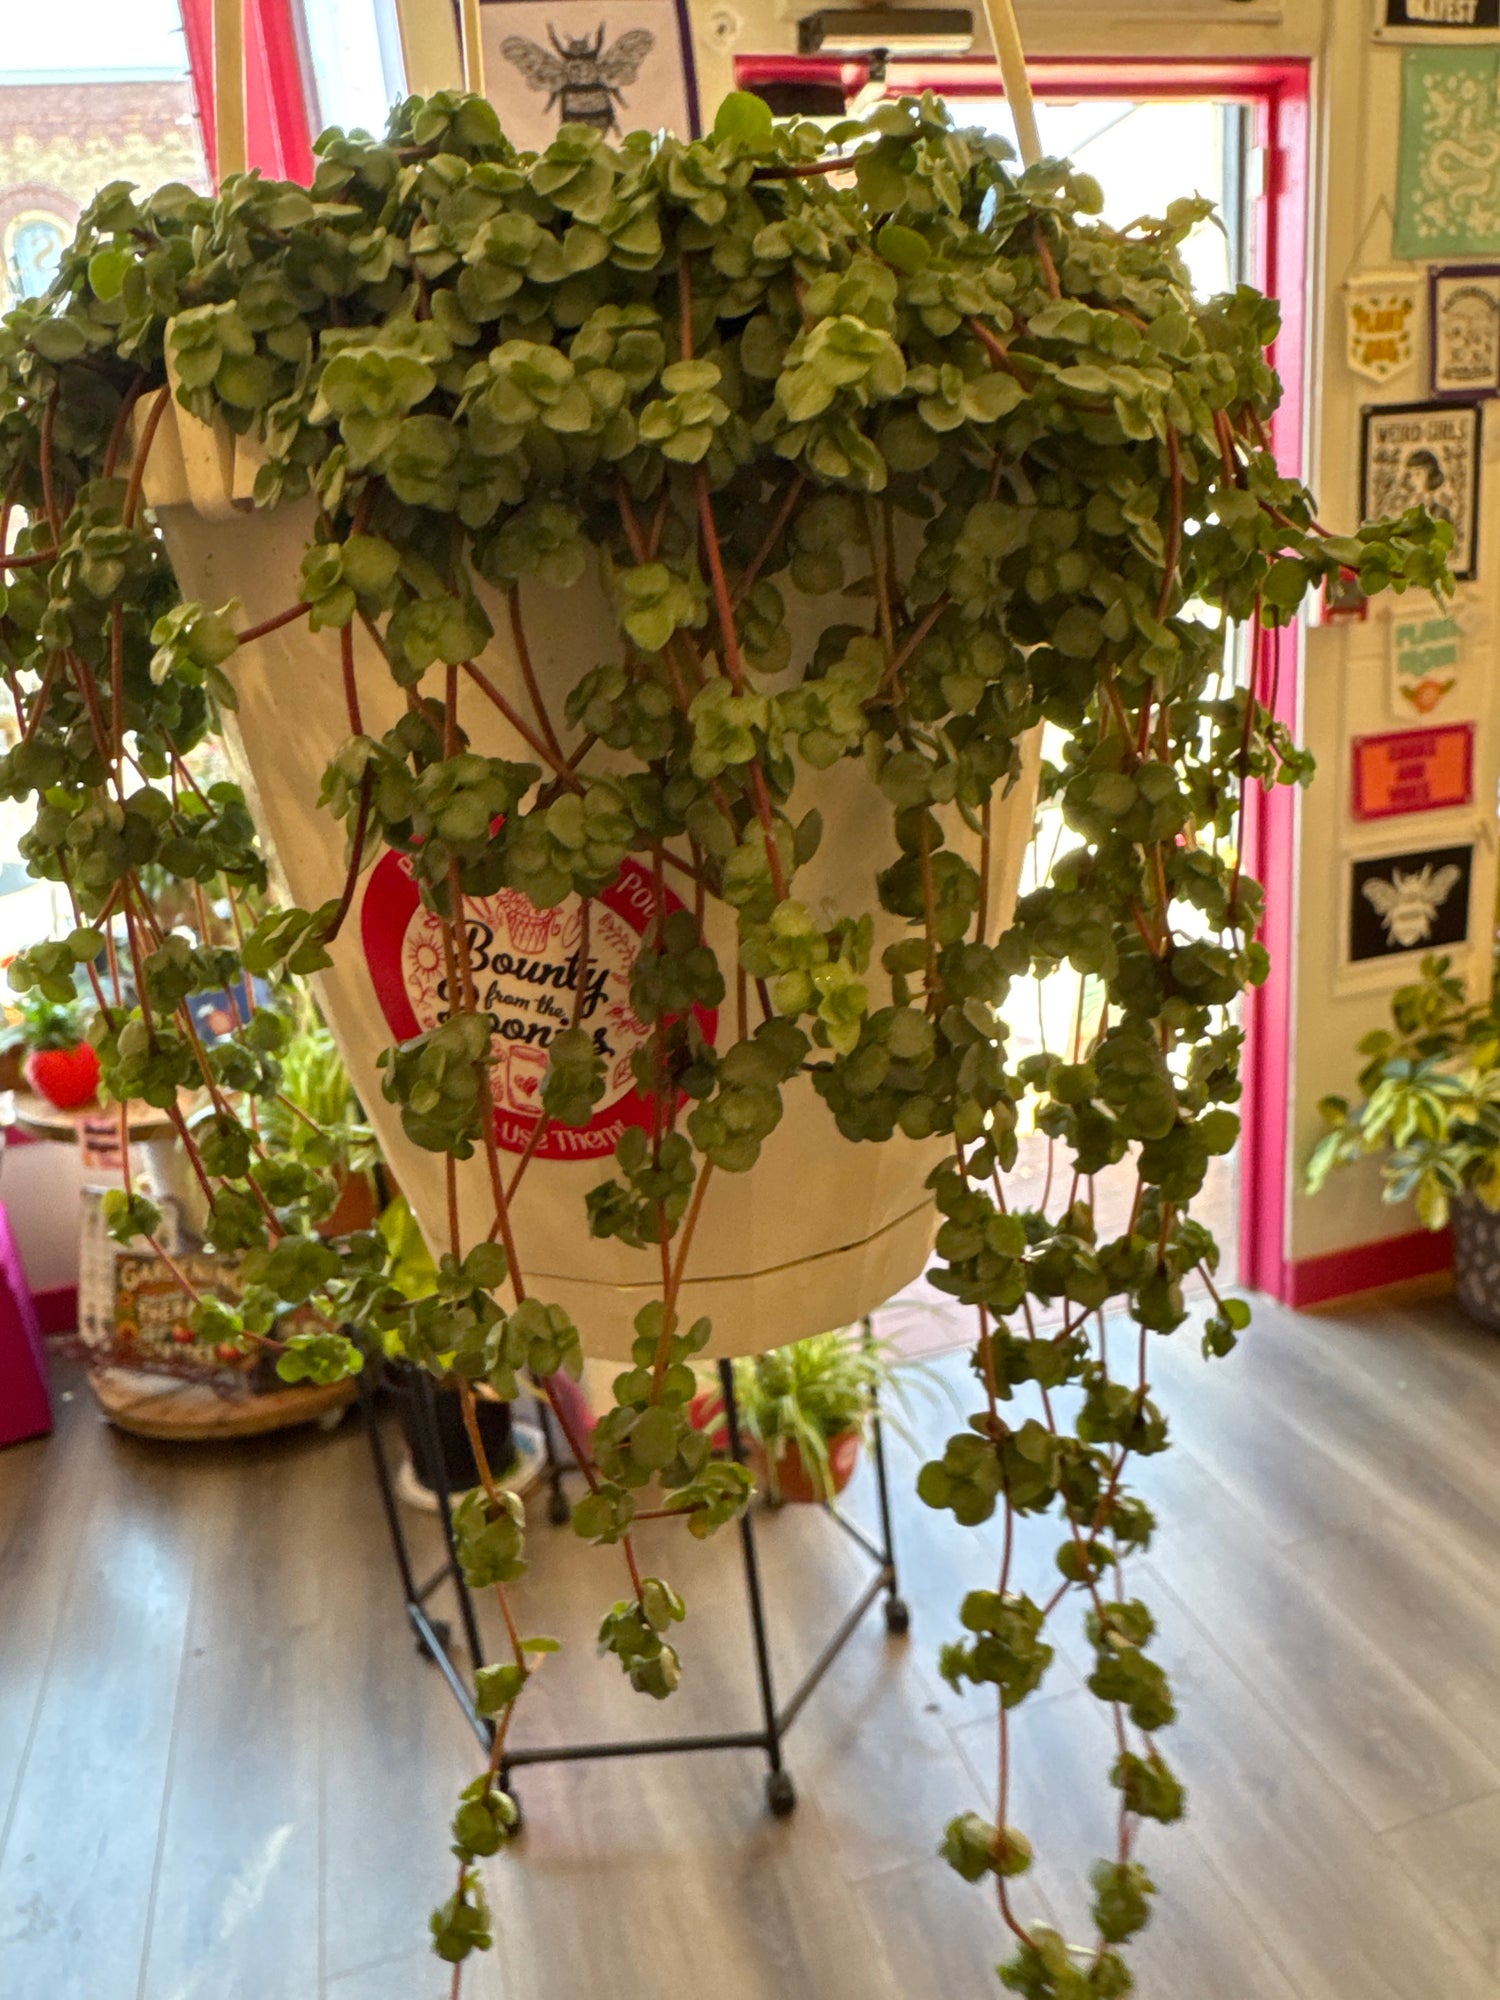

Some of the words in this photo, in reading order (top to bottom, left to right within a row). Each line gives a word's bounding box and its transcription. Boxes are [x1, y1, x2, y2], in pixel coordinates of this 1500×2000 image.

[451, 918, 610, 1019] Bounty
[484, 979, 530, 1010] from
[536, 993, 567, 1019] the
